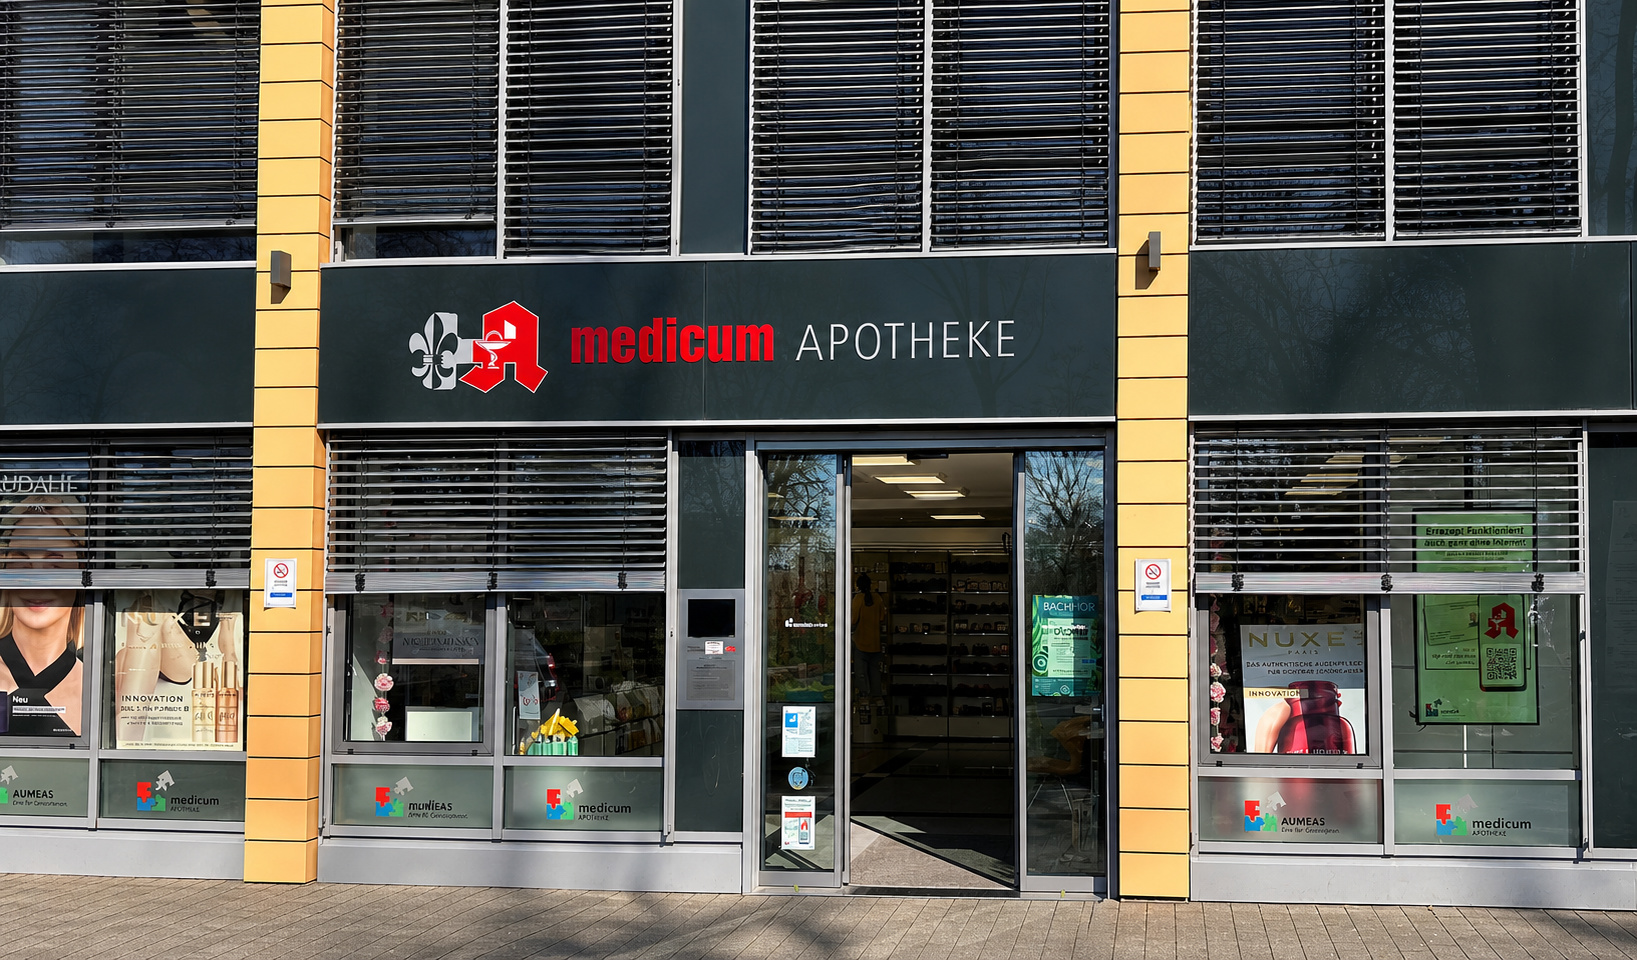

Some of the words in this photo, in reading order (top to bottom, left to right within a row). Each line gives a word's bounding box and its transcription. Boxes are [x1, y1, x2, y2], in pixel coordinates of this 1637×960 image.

[571, 317, 774, 364] medicum
[795, 320, 1015, 361] APOTHEKE
[1248, 631, 1346, 648] NUXE
[170, 795, 220, 806] medicum
[578, 802, 632, 814] medicum
[1472, 817, 1532, 830] medicum
